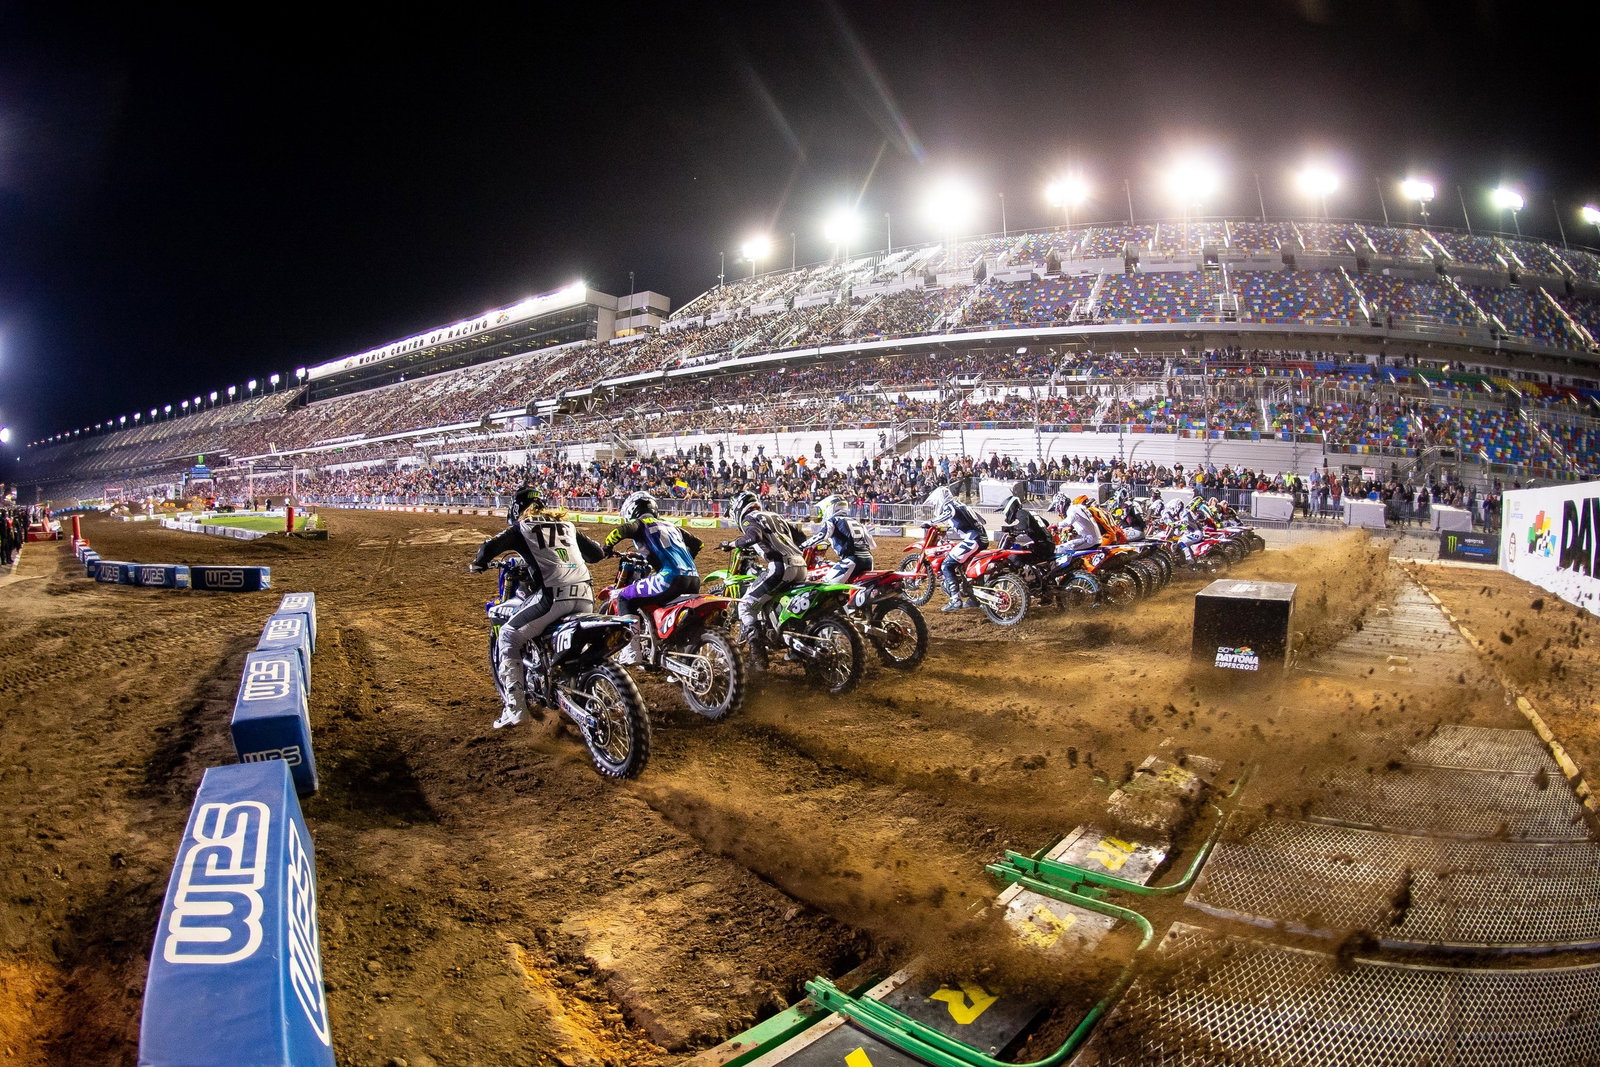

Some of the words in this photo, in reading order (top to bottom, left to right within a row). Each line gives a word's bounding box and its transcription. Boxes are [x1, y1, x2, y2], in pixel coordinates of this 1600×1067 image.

[359, 351, 386, 365] WORLD
[391, 339, 424, 355] CENTER
[430, 332, 443, 344] OF
[448, 319, 488, 338] RACING
[101, 565, 120, 582] WPS
[141, 568, 166, 585] WPS
[205, 570, 245, 587] WPS
[556, 585, 590, 598] FOX
[636, 574, 671, 595] FXR
[265, 618, 301, 642] WPS
[1214, 661, 1259, 671] SUPERCROSS
[1215, 653, 1259, 664] DAYTONA
[243, 660, 291, 701] WPS
[243, 746, 302, 767] WPS
[164, 800, 271, 964] WPS
[286, 817, 331, 1047] WPS
